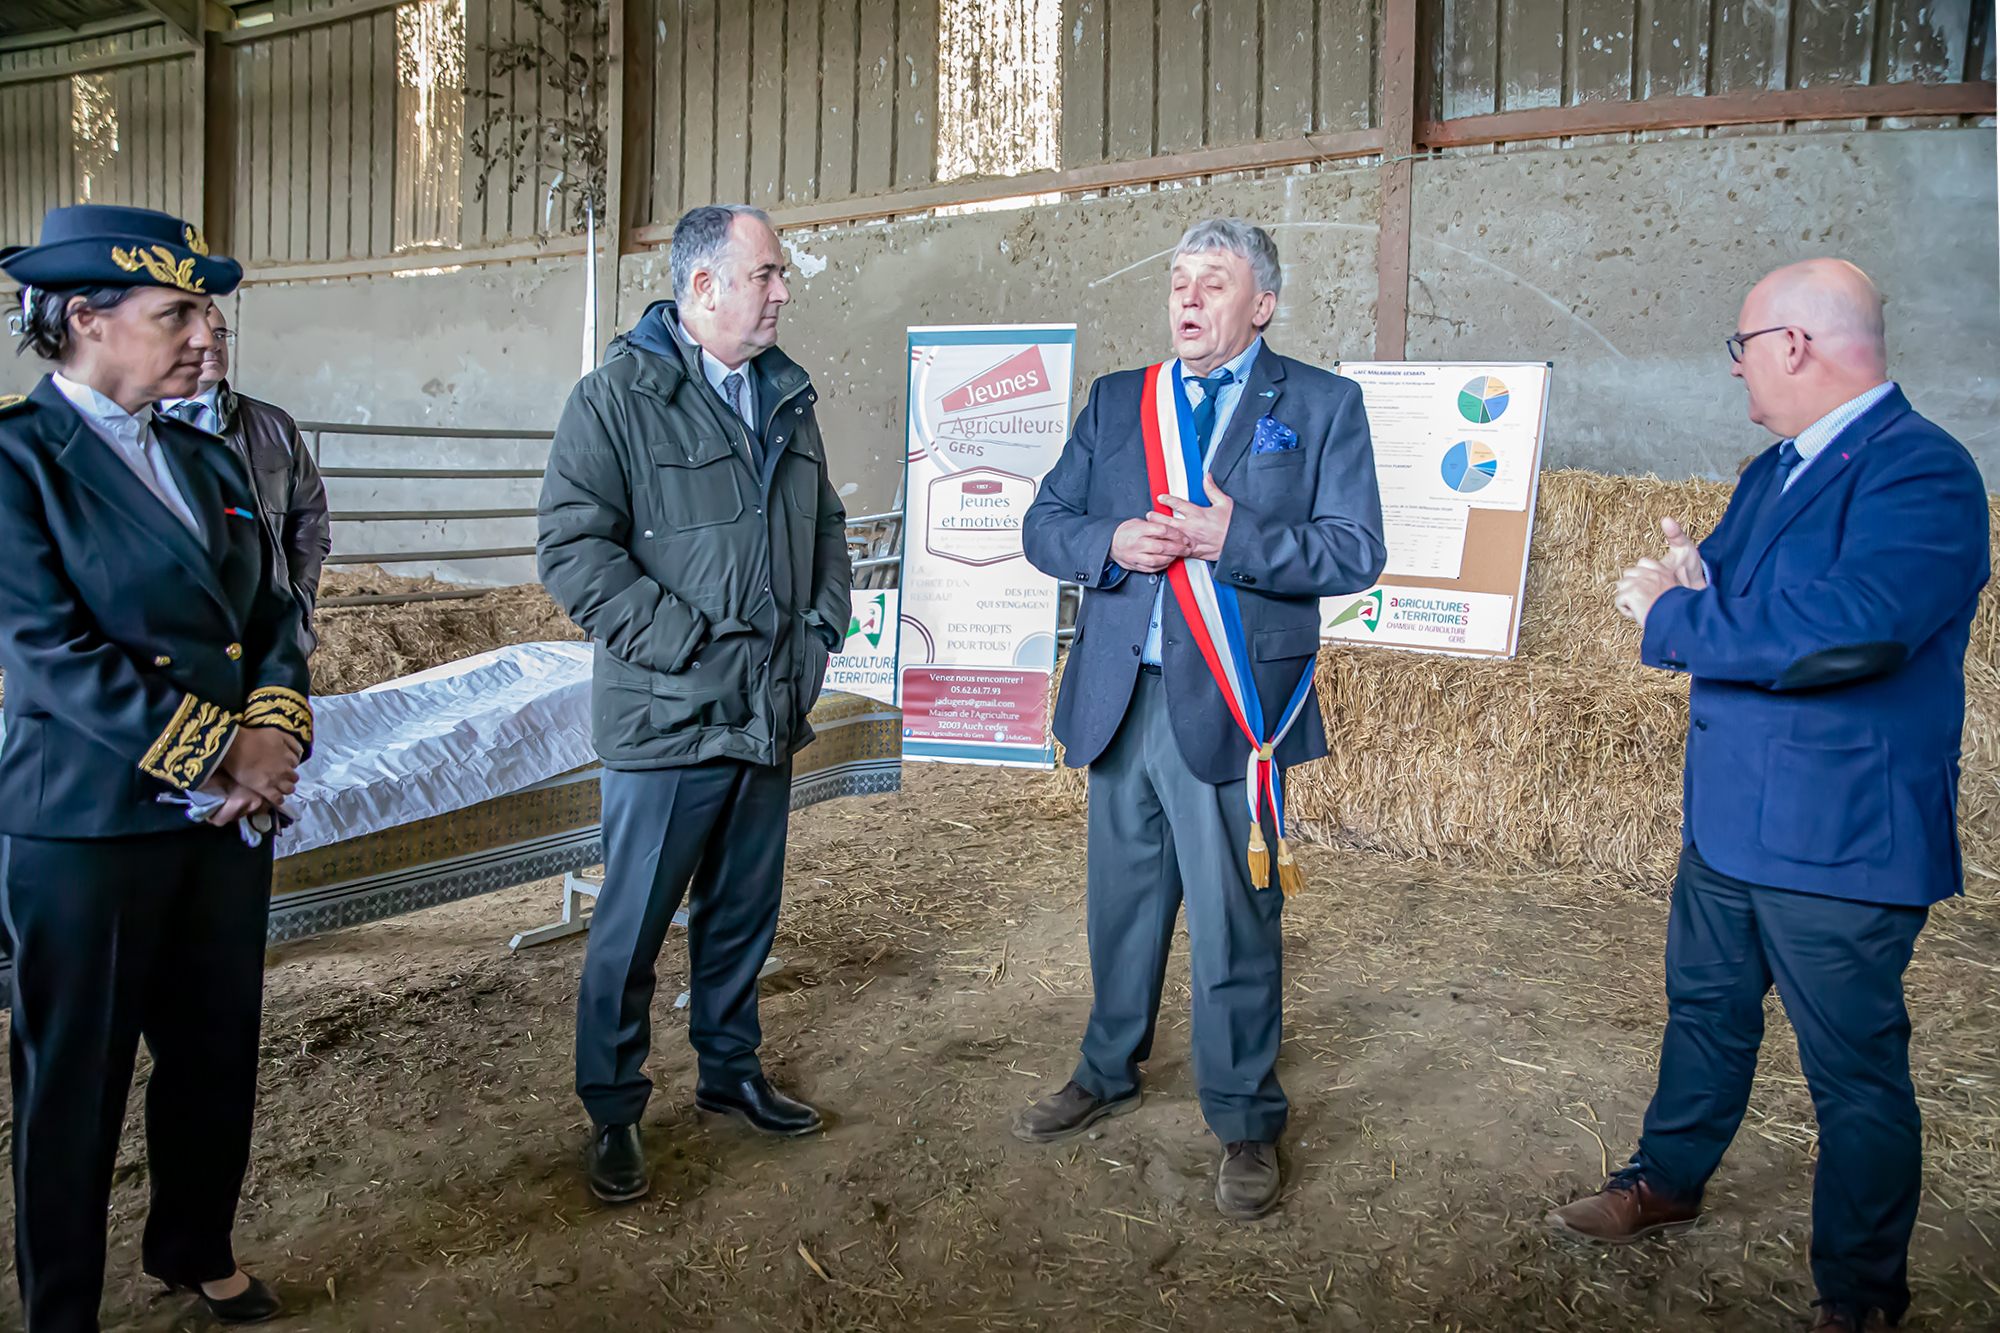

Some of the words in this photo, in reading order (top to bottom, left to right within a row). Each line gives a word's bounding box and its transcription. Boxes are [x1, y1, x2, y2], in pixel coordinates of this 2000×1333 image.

[964, 369, 1039, 407] Jeunes
[950, 415, 1064, 438] Agriculteurs
[949, 441, 985, 457] GERS
[960, 494, 1010, 511] Jeunes
[941, 516, 956, 528] et
[960, 514, 1019, 528] motivés
[1005, 588, 1022, 597] DES
[1024, 588, 1055, 598] JEUNES
[976, 600, 994, 610] QUI
[995, 600, 1050, 609] S'ENGAGENT
[1393, 612, 1400, 620] &
[1401, 610, 1469, 626] TERRITOIRES
[947, 623, 967, 633] DES
[970, 623, 1012, 636] PROJETS
[1386, 621, 1417, 631] CHAMBRE
[1419, 623, 1467, 636] D'AGRICULTURE
[1448, 634, 1466, 644] GERS
[947, 640, 979, 650] POUR
[979, 641, 1006, 651] TOUS
[825, 674, 831, 683] &
[929, 673, 955, 682] Venez
[955, 675, 975, 683] nous
[976, 675, 1020, 684] rencontrer
[950, 685, 1001, 696] 05.62.61.77.93
[934, 697, 1015, 708] jadugers@gmail.com
[929, 709, 958, 718] Maison
[959, 709, 970, 718] de
[971, 709, 1020, 721] l'Agriculture
[938, 721, 961, 730] 32003
[962, 721, 983, 731] Auch
[984, 722, 1008, 732] cedex
[931, 730, 963, 738] Agriculteurs
[972, 731, 985, 739] Gers
